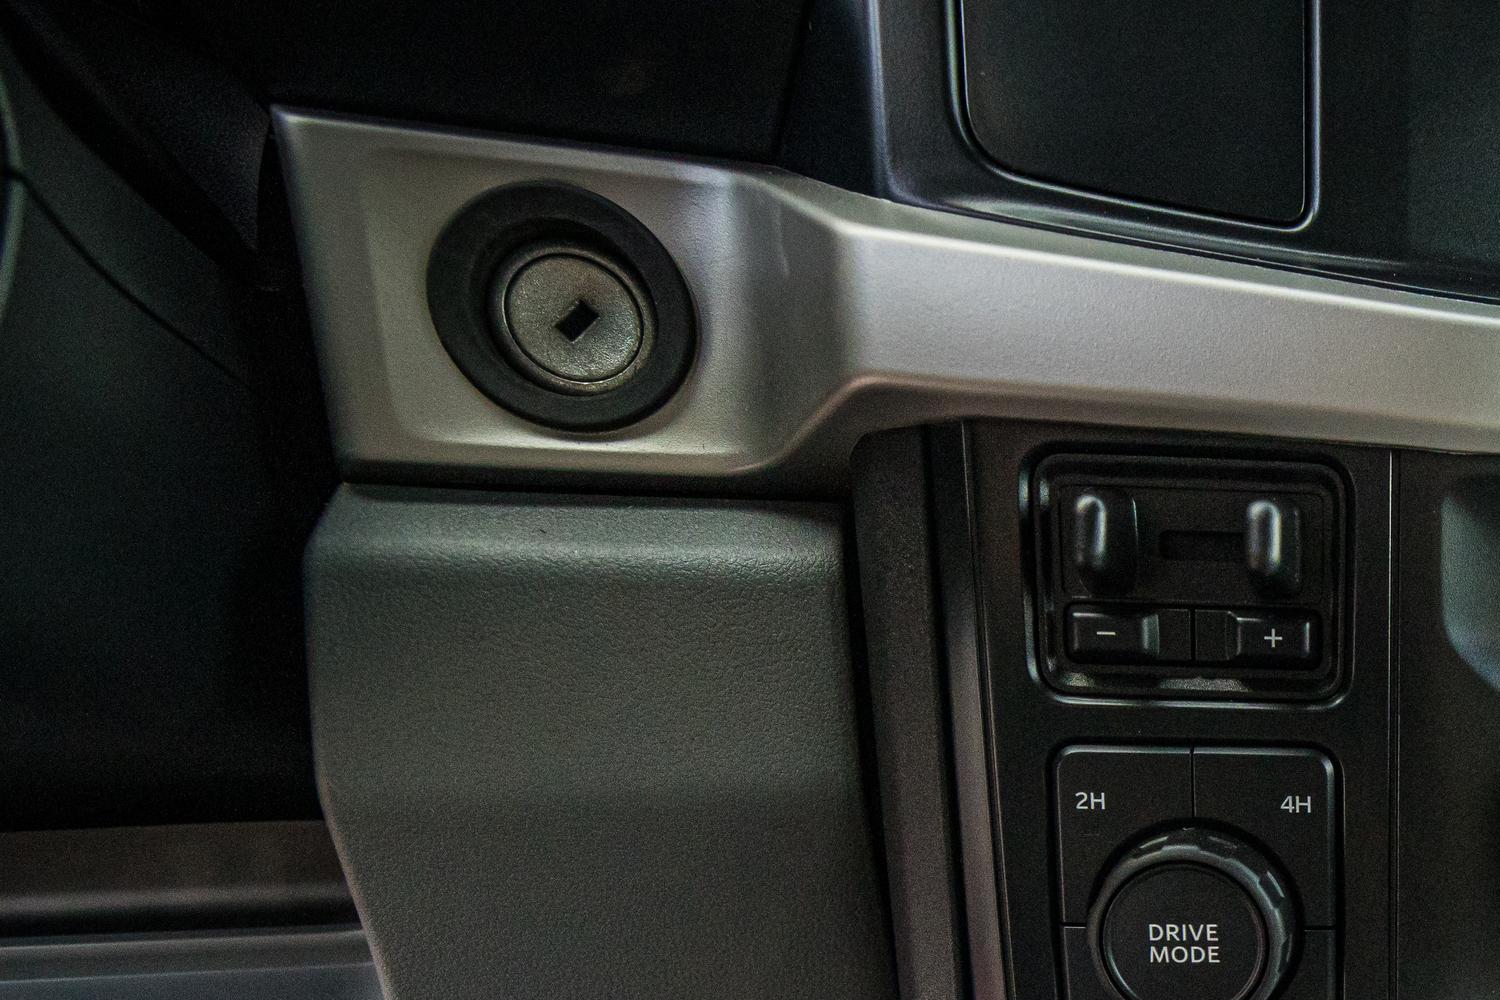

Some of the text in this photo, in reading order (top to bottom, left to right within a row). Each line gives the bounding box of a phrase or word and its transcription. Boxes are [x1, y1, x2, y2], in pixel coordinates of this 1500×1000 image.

[1075, 792, 1106, 810] 2H
[1280, 795, 1312, 814] 4H
[1149, 923, 1219, 942] DRIVE
[1150, 945, 1221, 964] MODE
